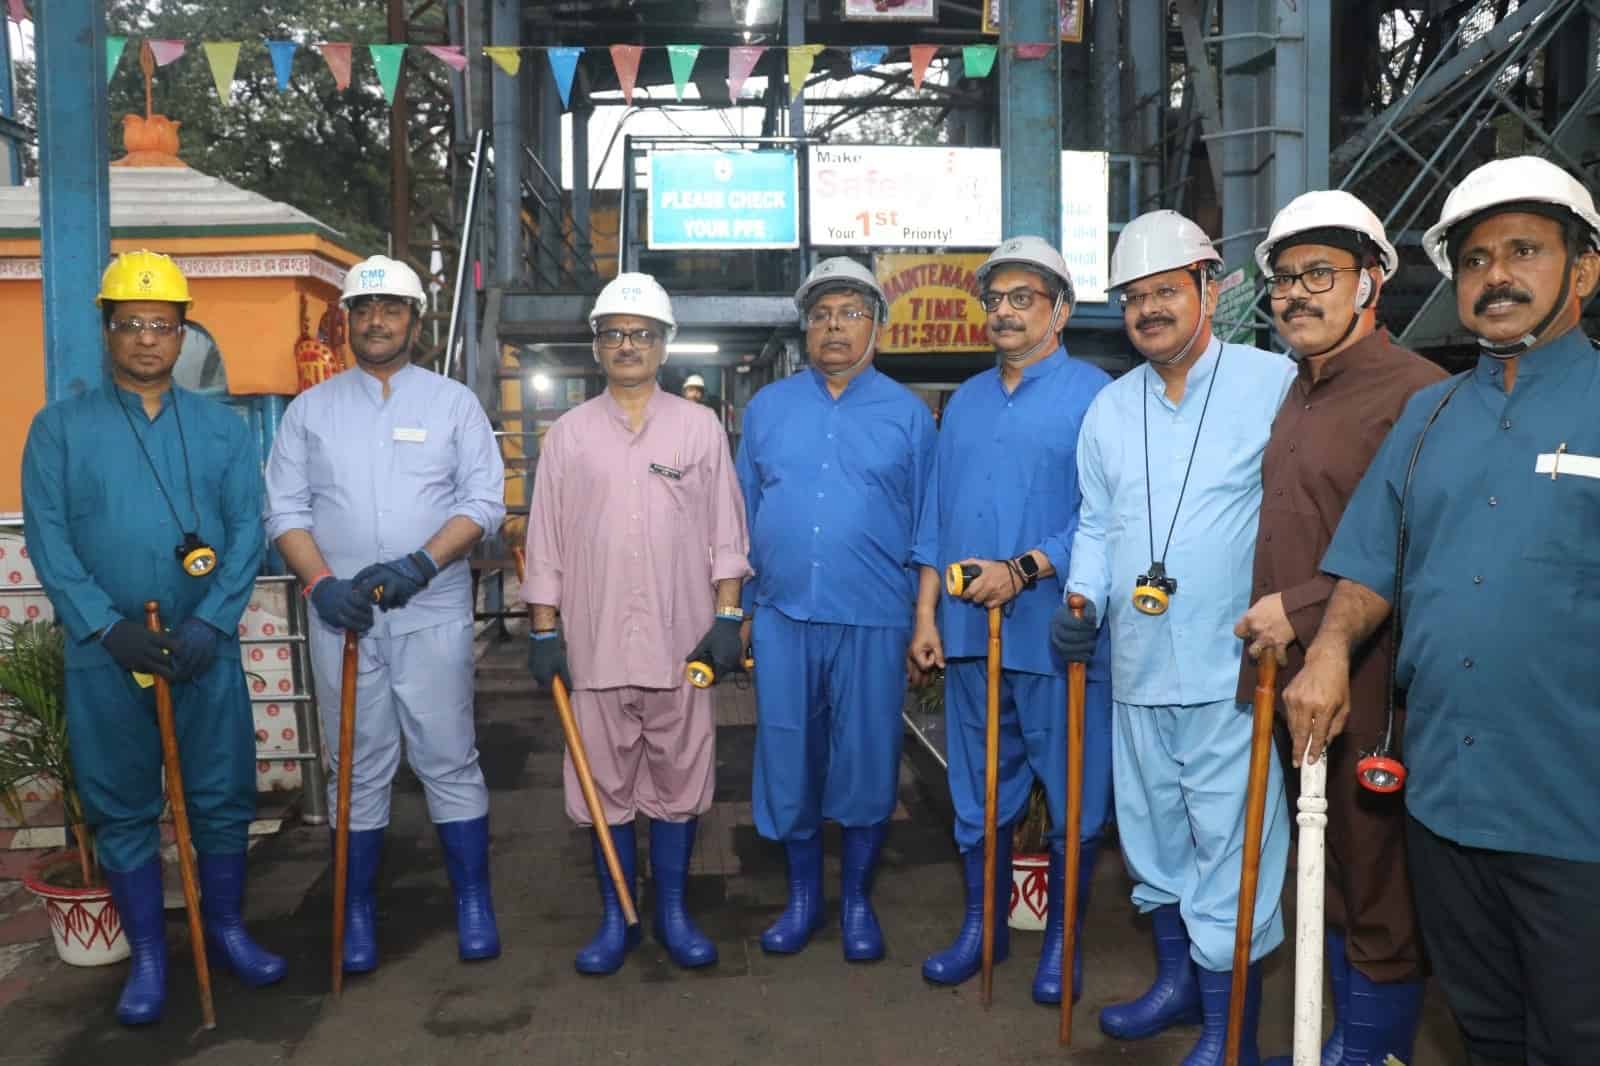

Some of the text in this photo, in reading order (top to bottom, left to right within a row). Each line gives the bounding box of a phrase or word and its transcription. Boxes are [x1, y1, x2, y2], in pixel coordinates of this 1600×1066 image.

[816, 151, 863, 164] Make
[661, 190, 787, 209] PLEASE CHECK
[684, 218, 729, 239] YOUR
[827, 208, 953, 242] Your 1st Priority!
[360, 268, 385, 280] CMD
[909, 297, 968, 321] TIME
[888, 322, 991, 347] 11:30AM
